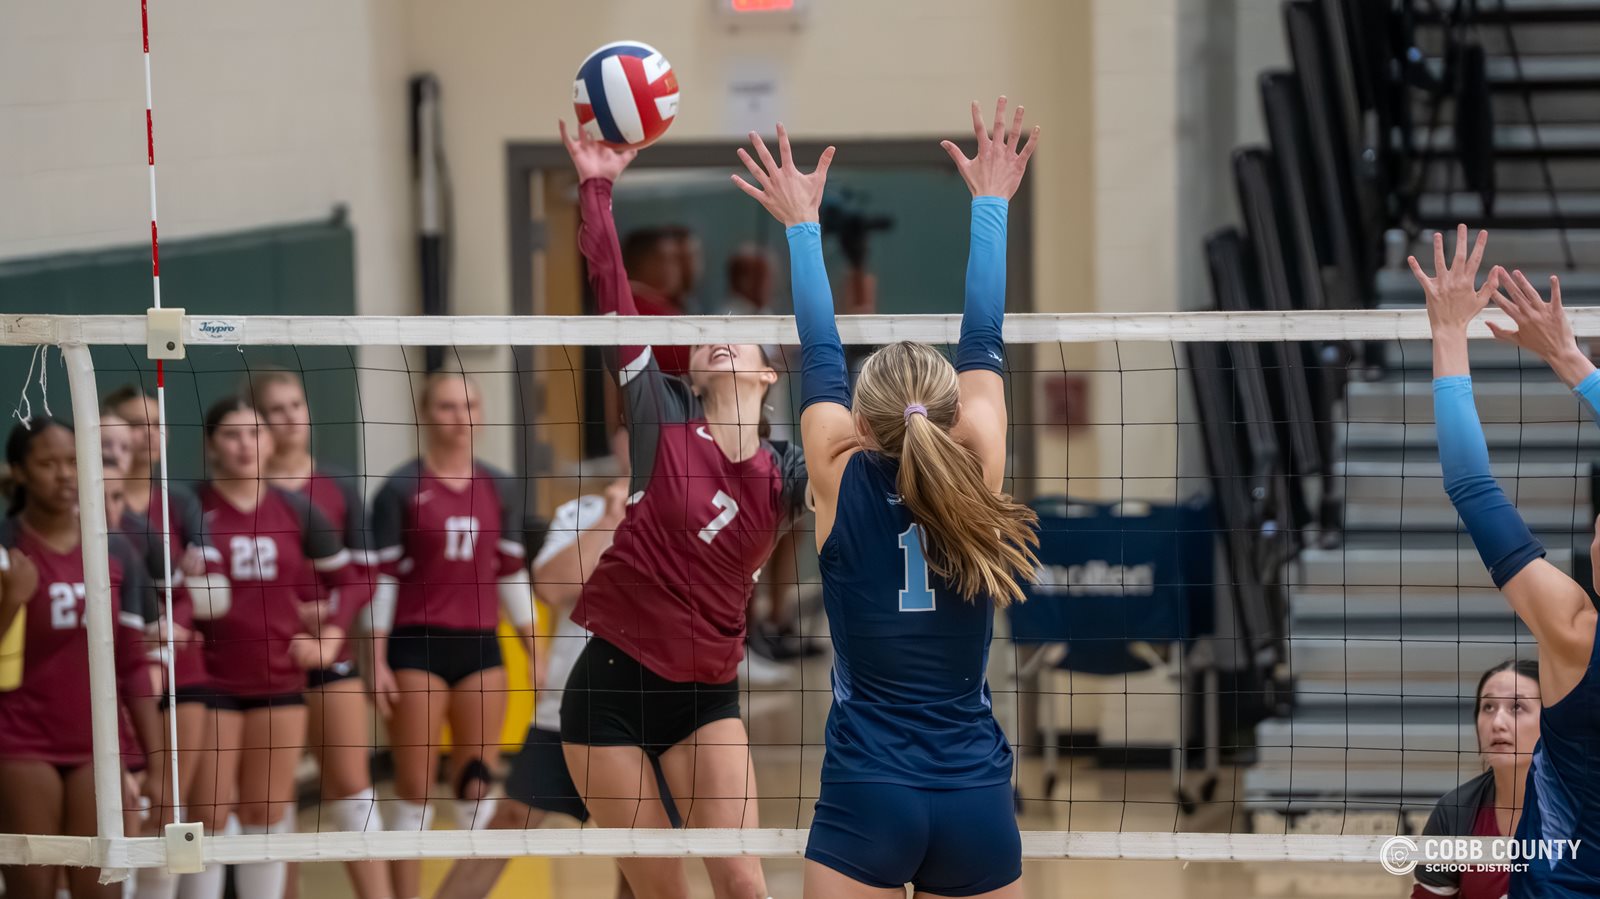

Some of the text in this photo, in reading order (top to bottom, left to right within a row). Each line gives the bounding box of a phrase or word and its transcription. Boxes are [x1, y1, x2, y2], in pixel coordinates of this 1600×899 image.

[199, 321, 236, 333] Jaypro
[445, 515, 480, 561] 17
[697, 490, 739, 544] 7
[229, 535, 278, 581] 22
[898, 522, 936, 612] 1
